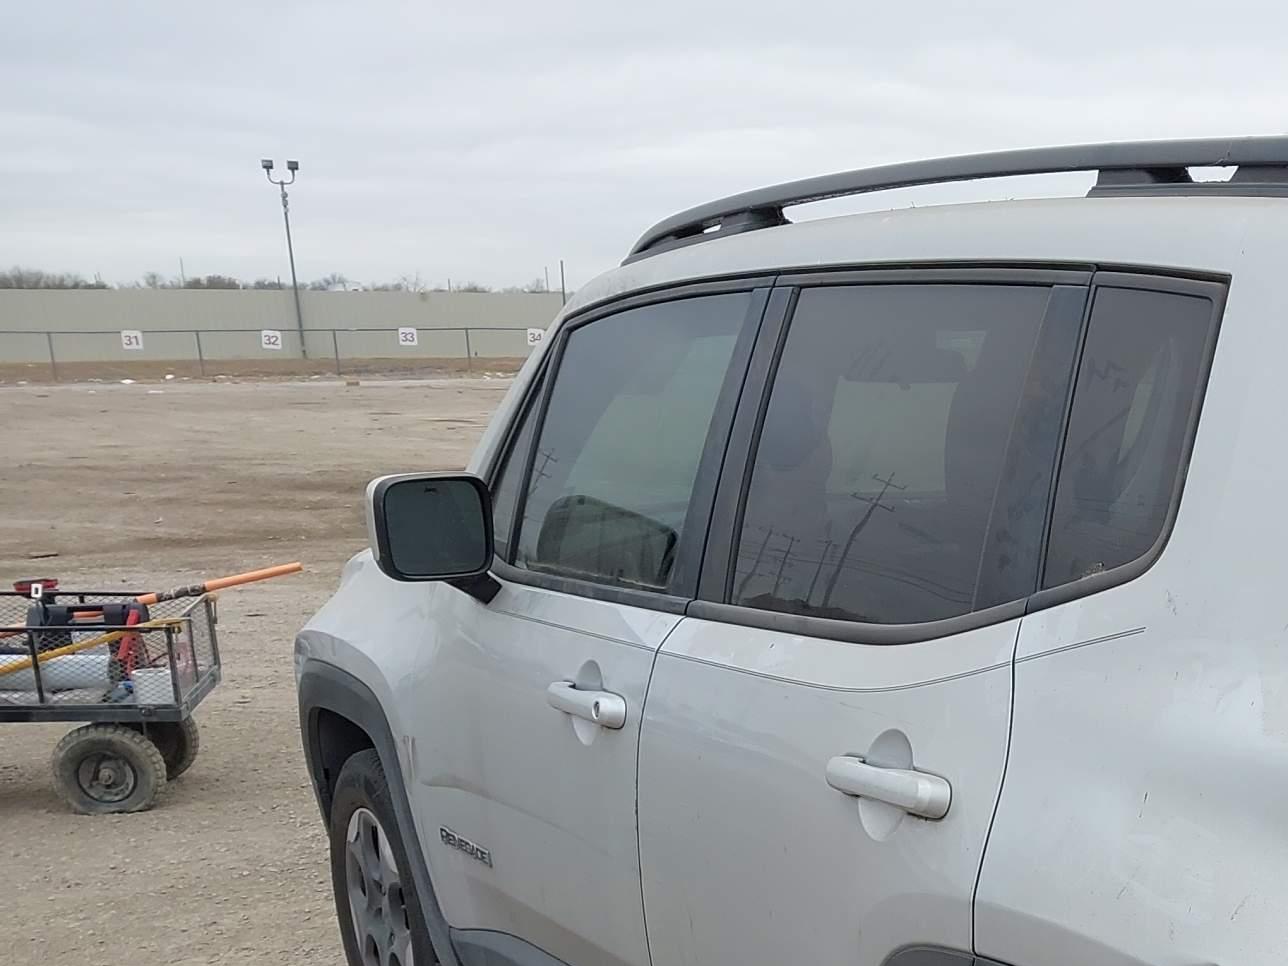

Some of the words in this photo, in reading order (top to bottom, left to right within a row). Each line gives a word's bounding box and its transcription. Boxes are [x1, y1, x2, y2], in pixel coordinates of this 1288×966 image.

[123, 335, 140, 346] 31
[263, 335, 279, 346] 32
[400, 331, 416, 342] 33
[529, 333, 542, 342] 34
